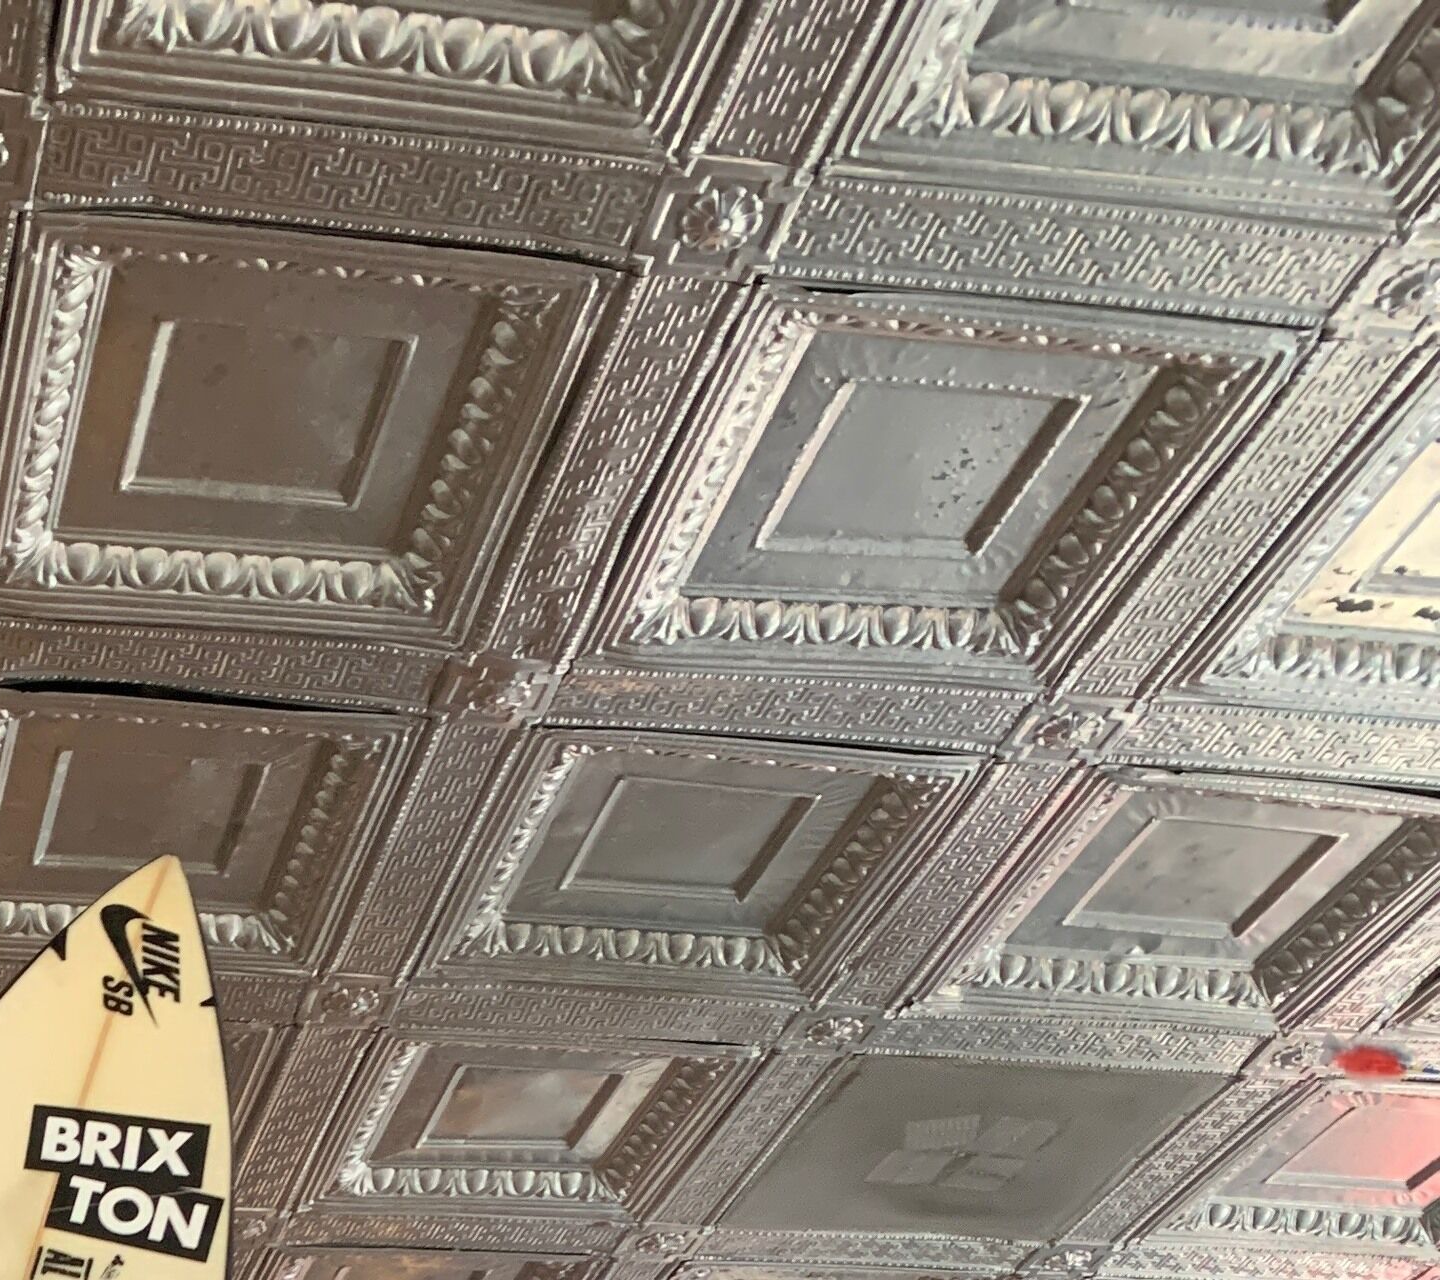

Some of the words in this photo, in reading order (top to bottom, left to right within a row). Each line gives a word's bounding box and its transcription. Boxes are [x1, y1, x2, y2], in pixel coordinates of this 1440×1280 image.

[142, 921, 181, 1003] NIKE
[102, 974, 134, 1017] SB
[40, 1115, 194, 1178] BRIX
[68, 1176, 211, 1251] TON
[41, 1248, 85, 1279] AL
